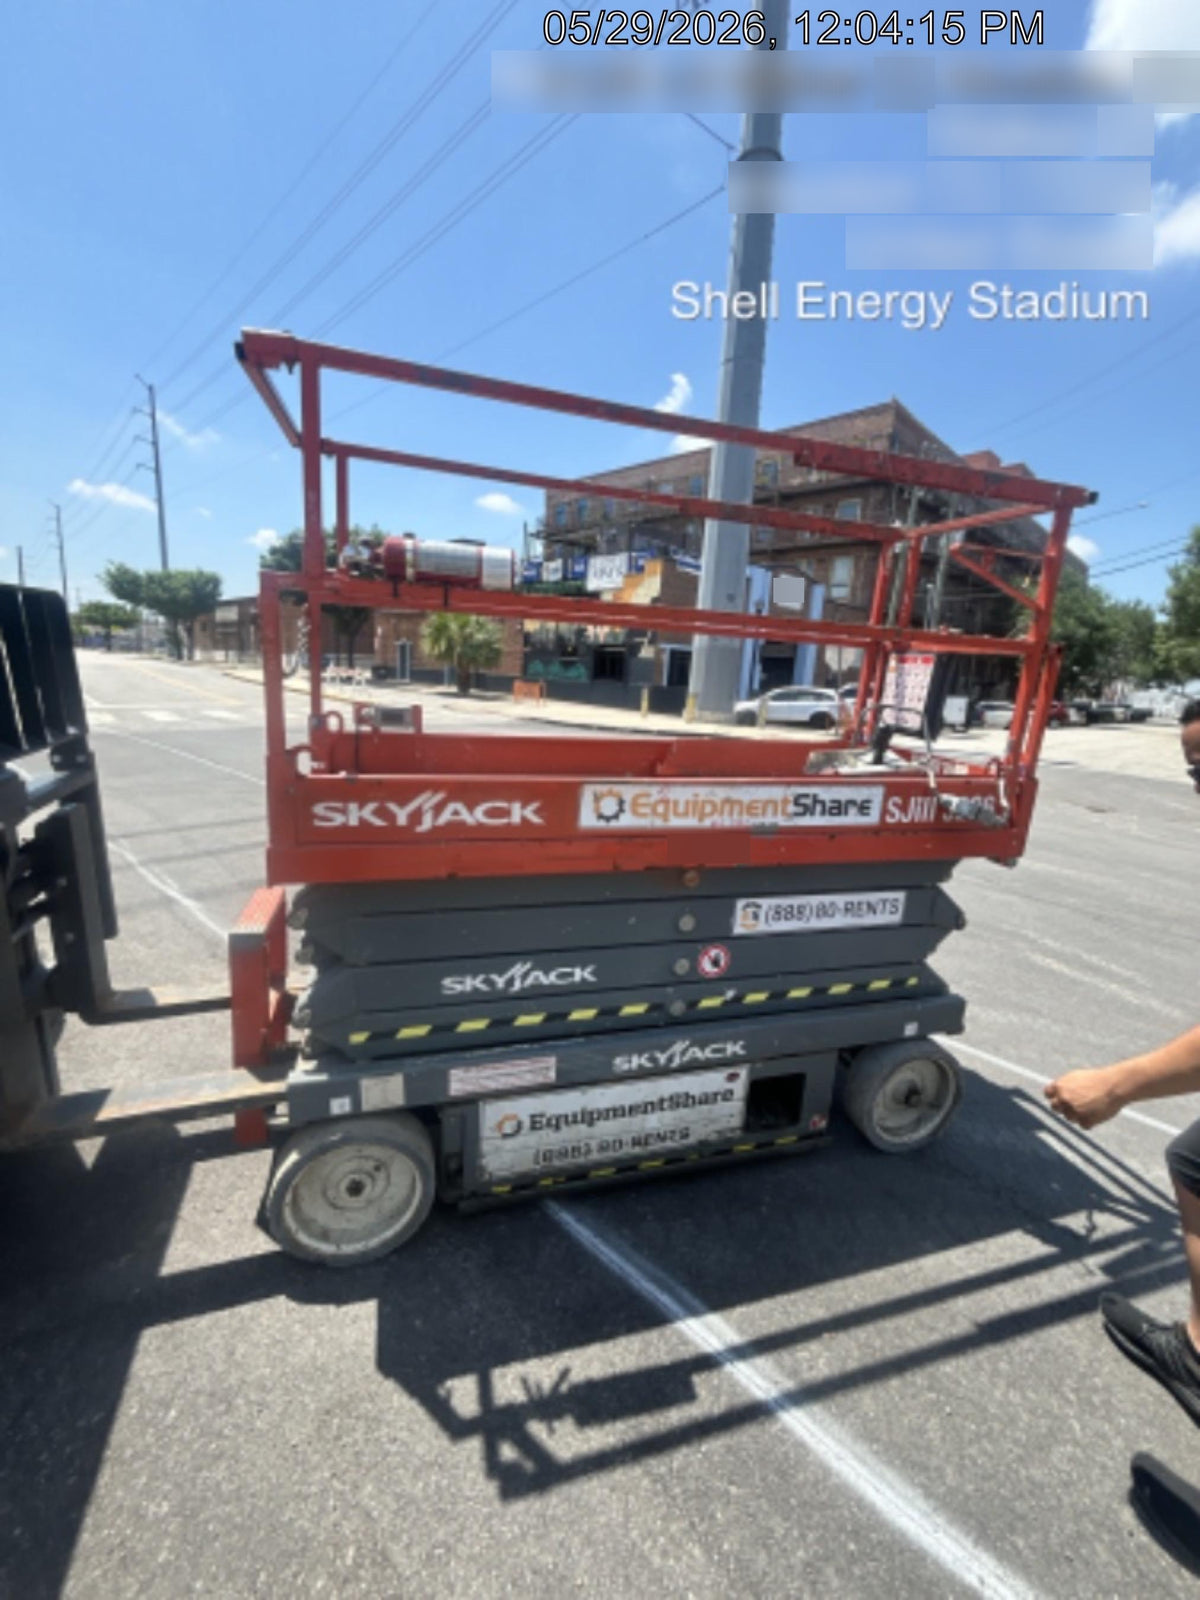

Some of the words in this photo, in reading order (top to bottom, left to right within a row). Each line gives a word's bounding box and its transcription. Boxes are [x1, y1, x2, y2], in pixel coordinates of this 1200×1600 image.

[311, 789, 545, 833] SKYJACK
[630, 792, 872, 825] EquipmentShare
[441, 960, 597, 996] SKYJACK
[612, 1040, 747, 1073] SKYJACK
[529, 1089, 734, 1131] EquipmentShare
